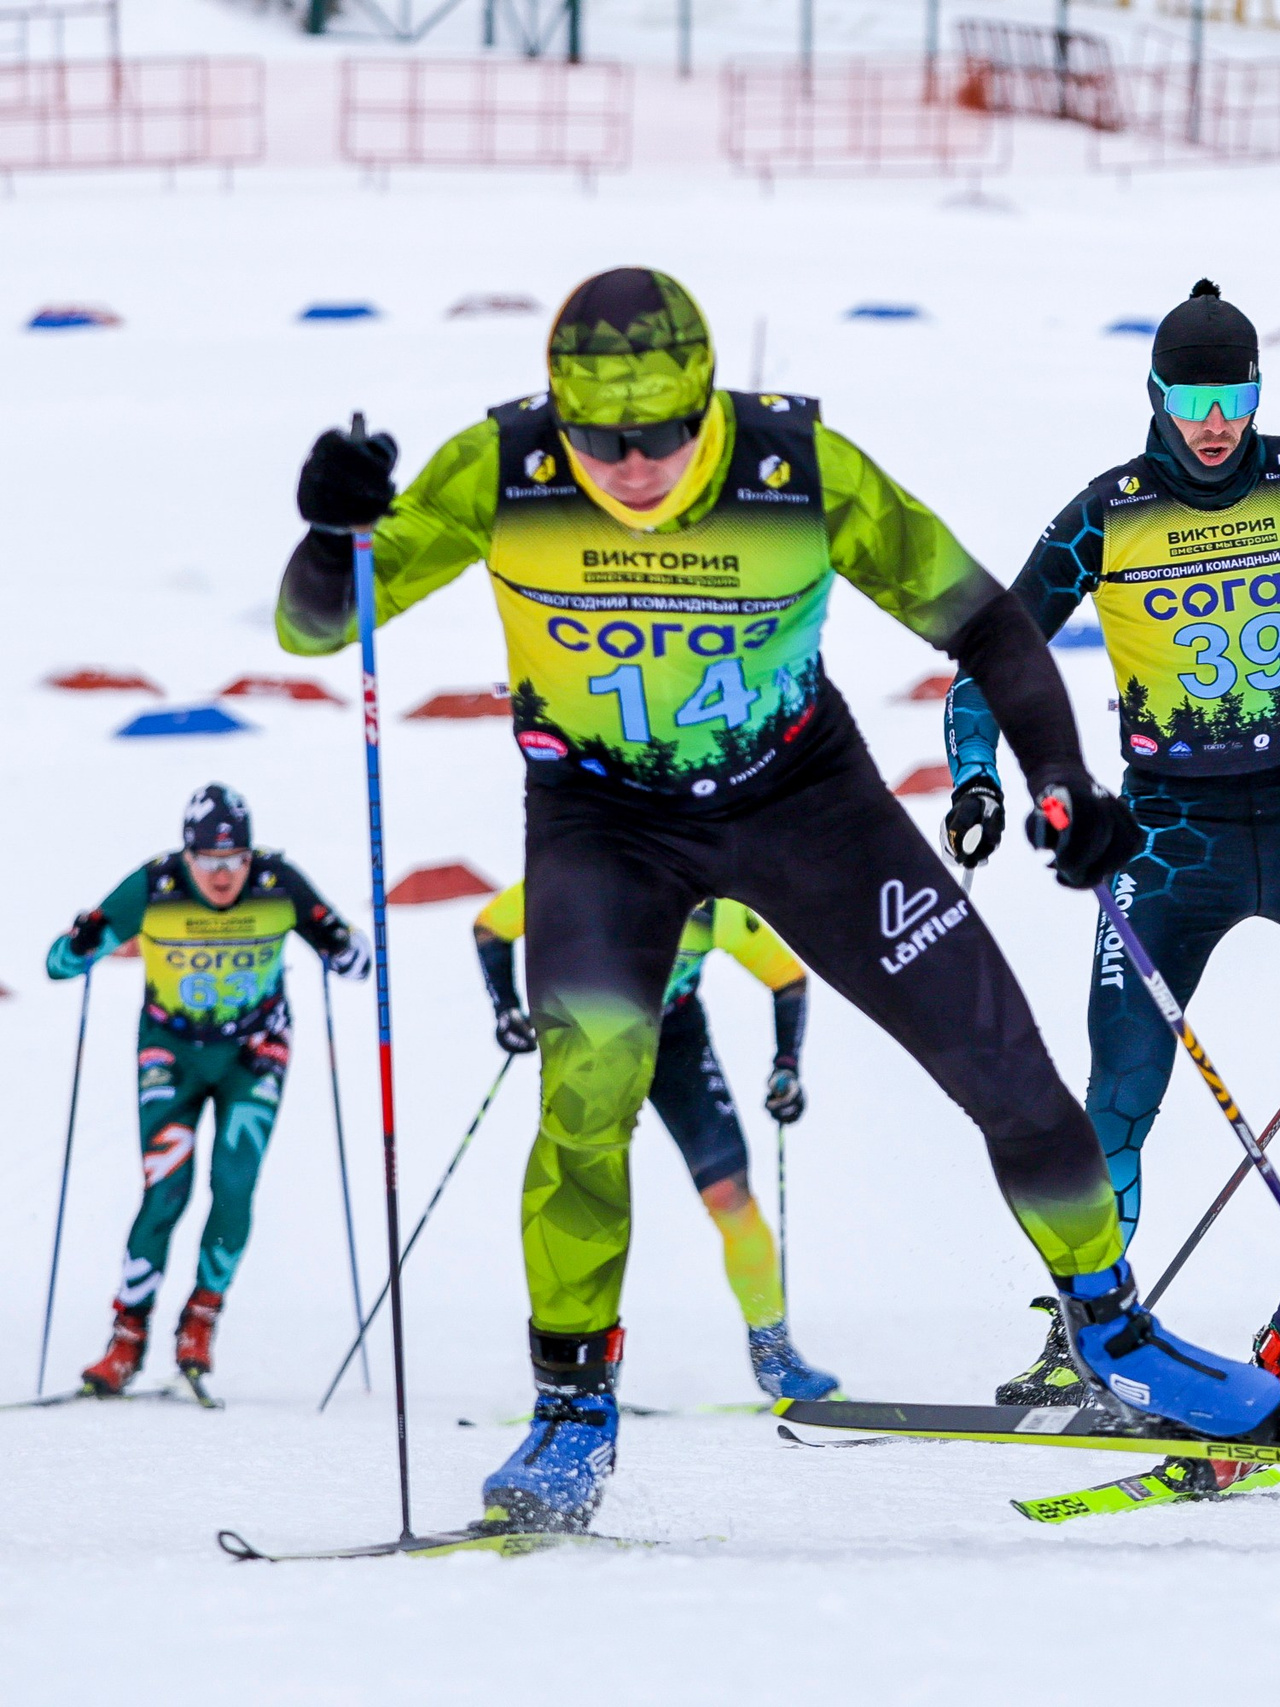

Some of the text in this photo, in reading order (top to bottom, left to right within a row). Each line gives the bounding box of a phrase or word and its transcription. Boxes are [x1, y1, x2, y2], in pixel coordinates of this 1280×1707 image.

[1168, 517, 1276, 544] ВИКТОРИЯ
[1215, 539, 1233, 550] мы
[1235, 534, 1277, 547] строим
[583, 550, 740, 571] ВИКТОРИЯ
[1124, 563, 1204, 581] НОВОГОДНИЙ
[1205, 552, 1280, 572] КОМАНДНЫЙ
[588, 657, 761, 742] 14
[179, 970, 258, 1011] 63
